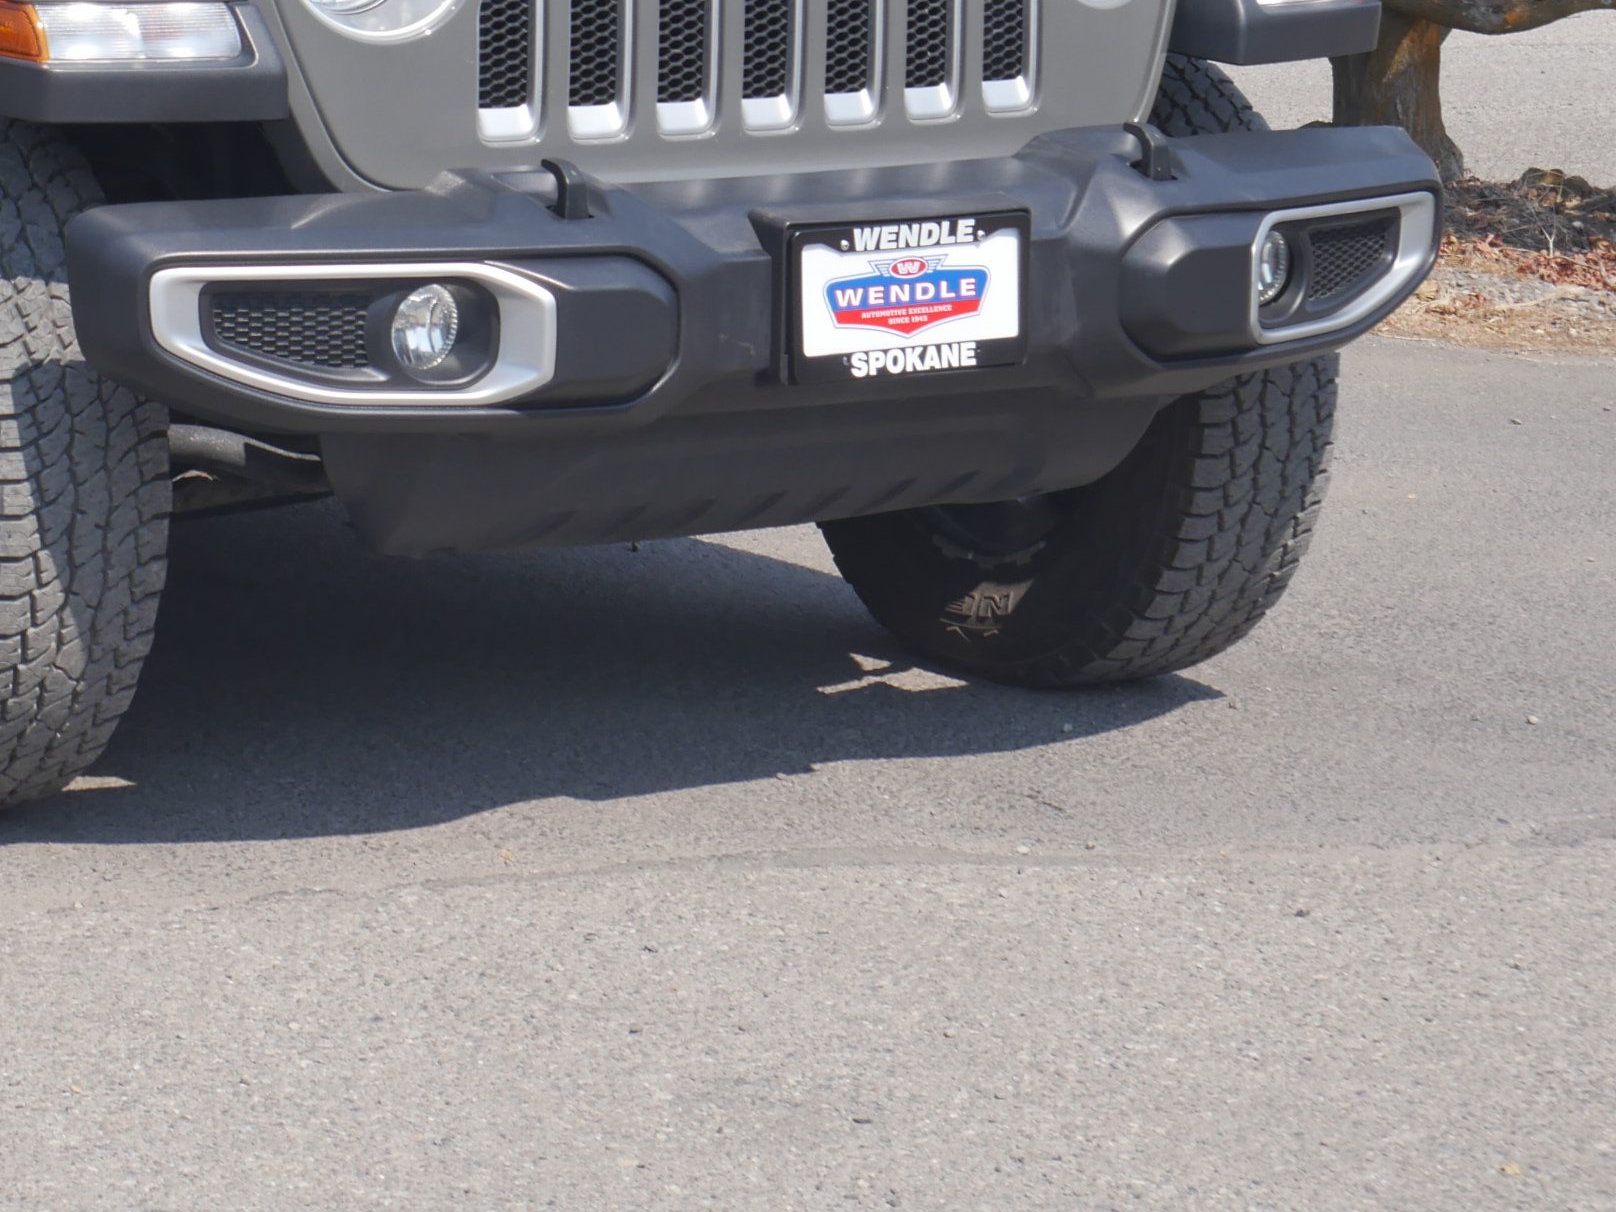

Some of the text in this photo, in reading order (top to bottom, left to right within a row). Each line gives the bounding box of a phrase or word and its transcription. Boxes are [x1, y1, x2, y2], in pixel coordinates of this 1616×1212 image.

[852, 218, 976, 252] WENDLE
[835, 278, 977, 307] WENDLE
[850, 341, 977, 378] SPOKANE
